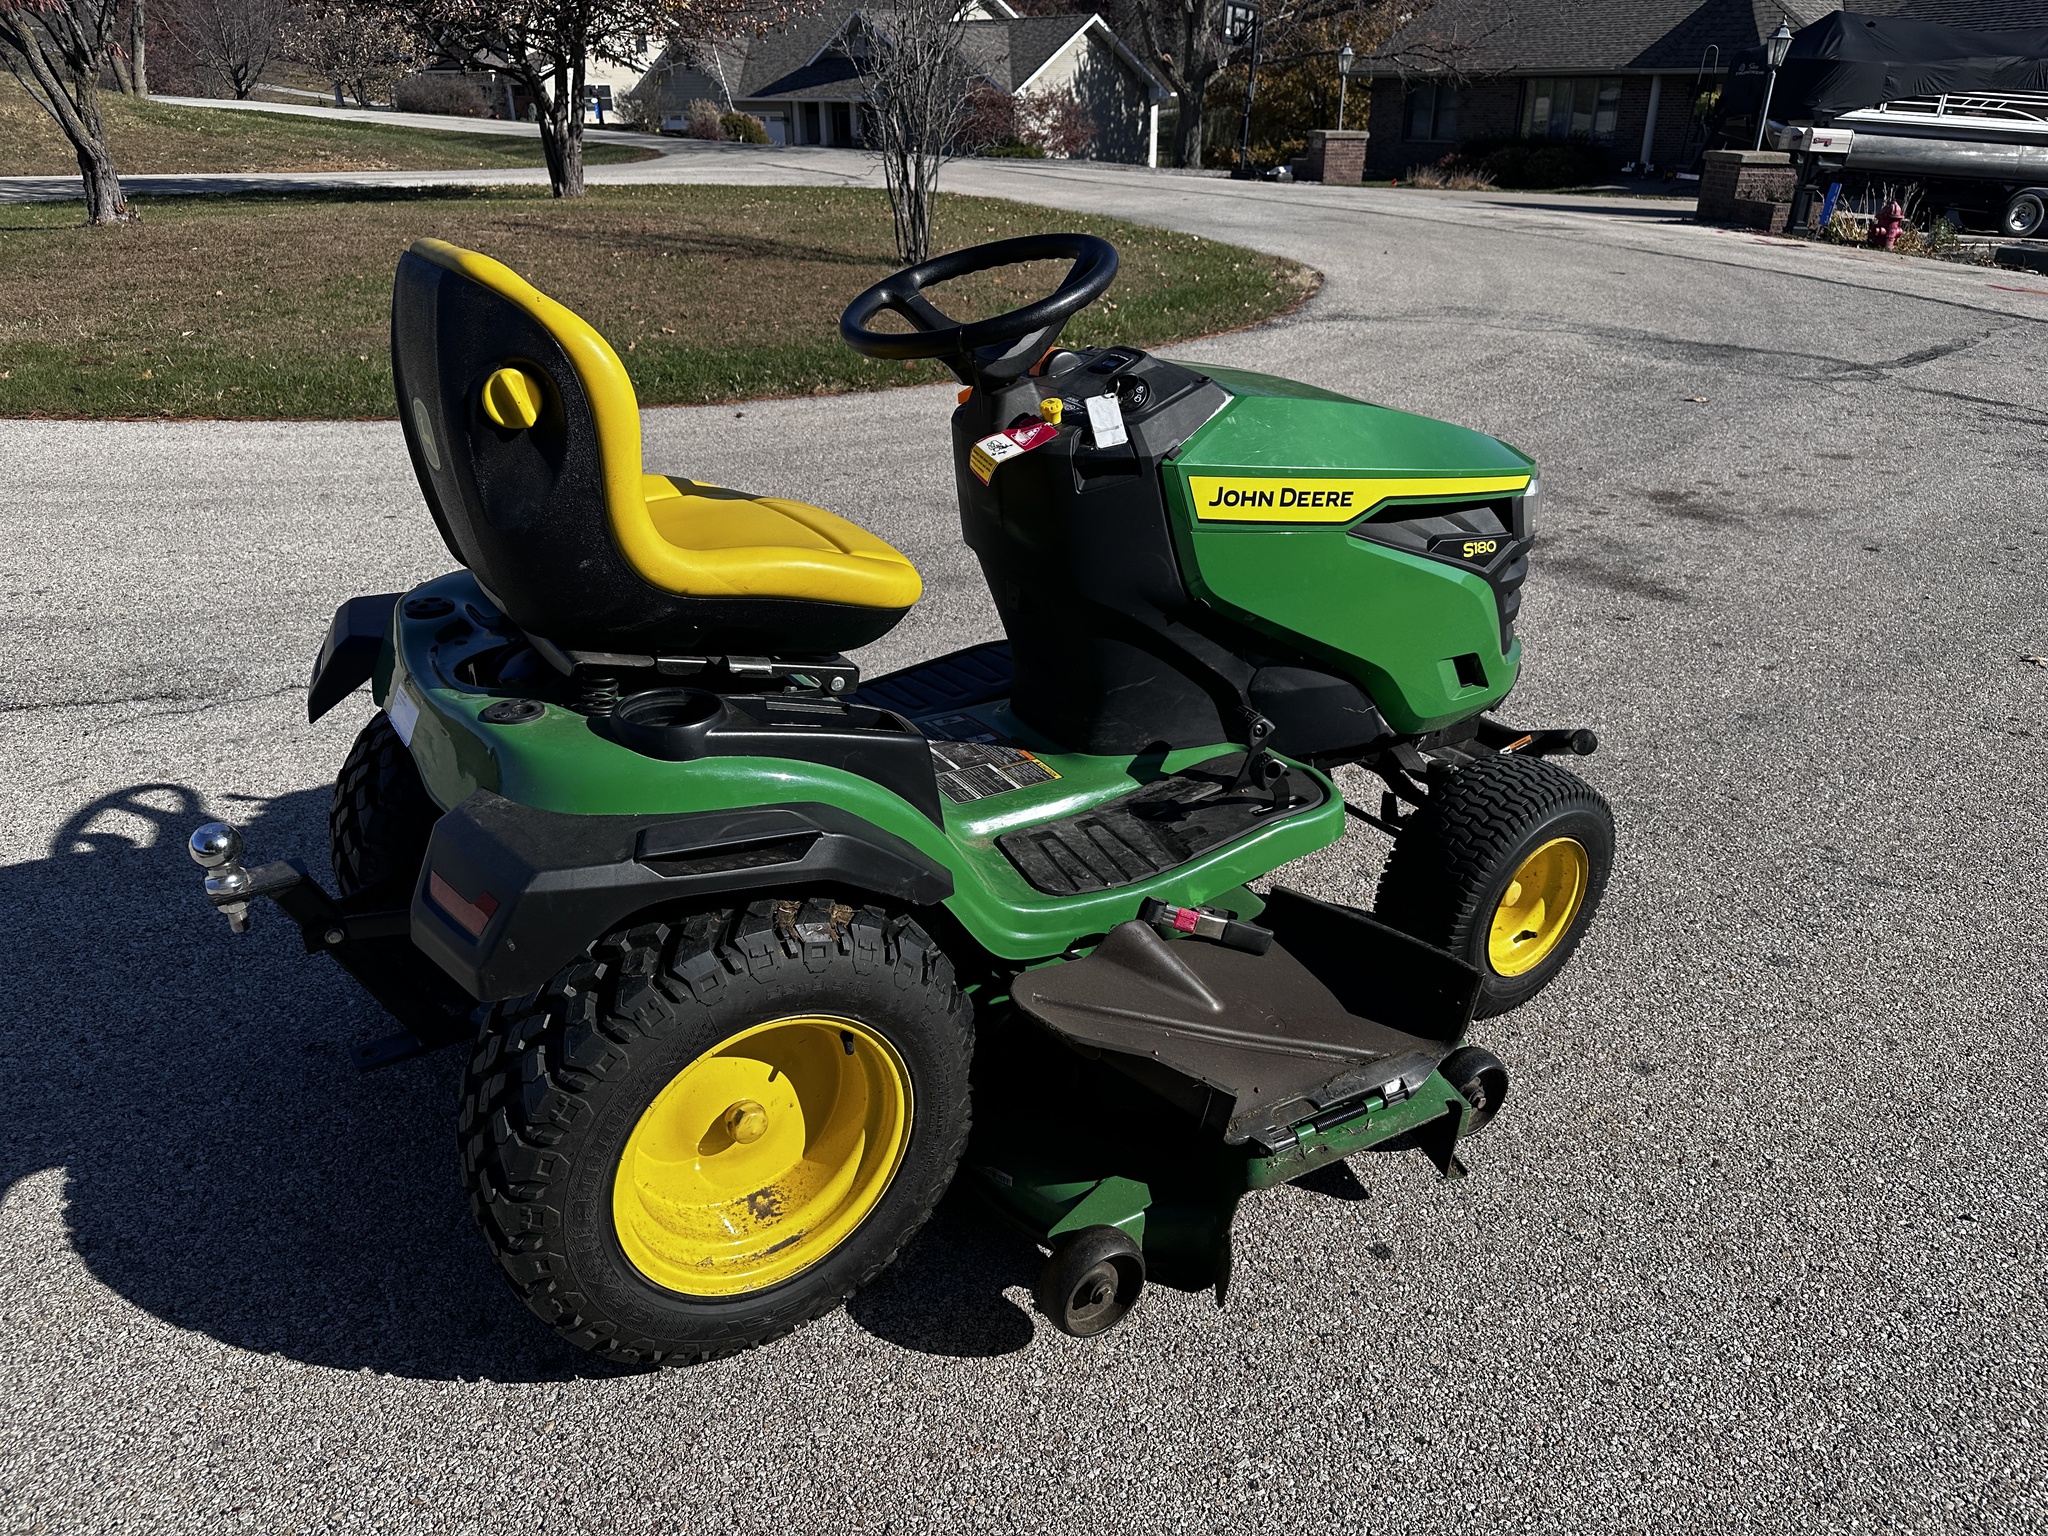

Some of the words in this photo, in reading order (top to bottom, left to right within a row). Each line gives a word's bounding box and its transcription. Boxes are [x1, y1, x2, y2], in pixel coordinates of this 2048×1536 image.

[1208, 486, 1275, 507] JOHN
[1279, 487, 1354, 508] DEERE
[1463, 541, 1497, 558] S180
